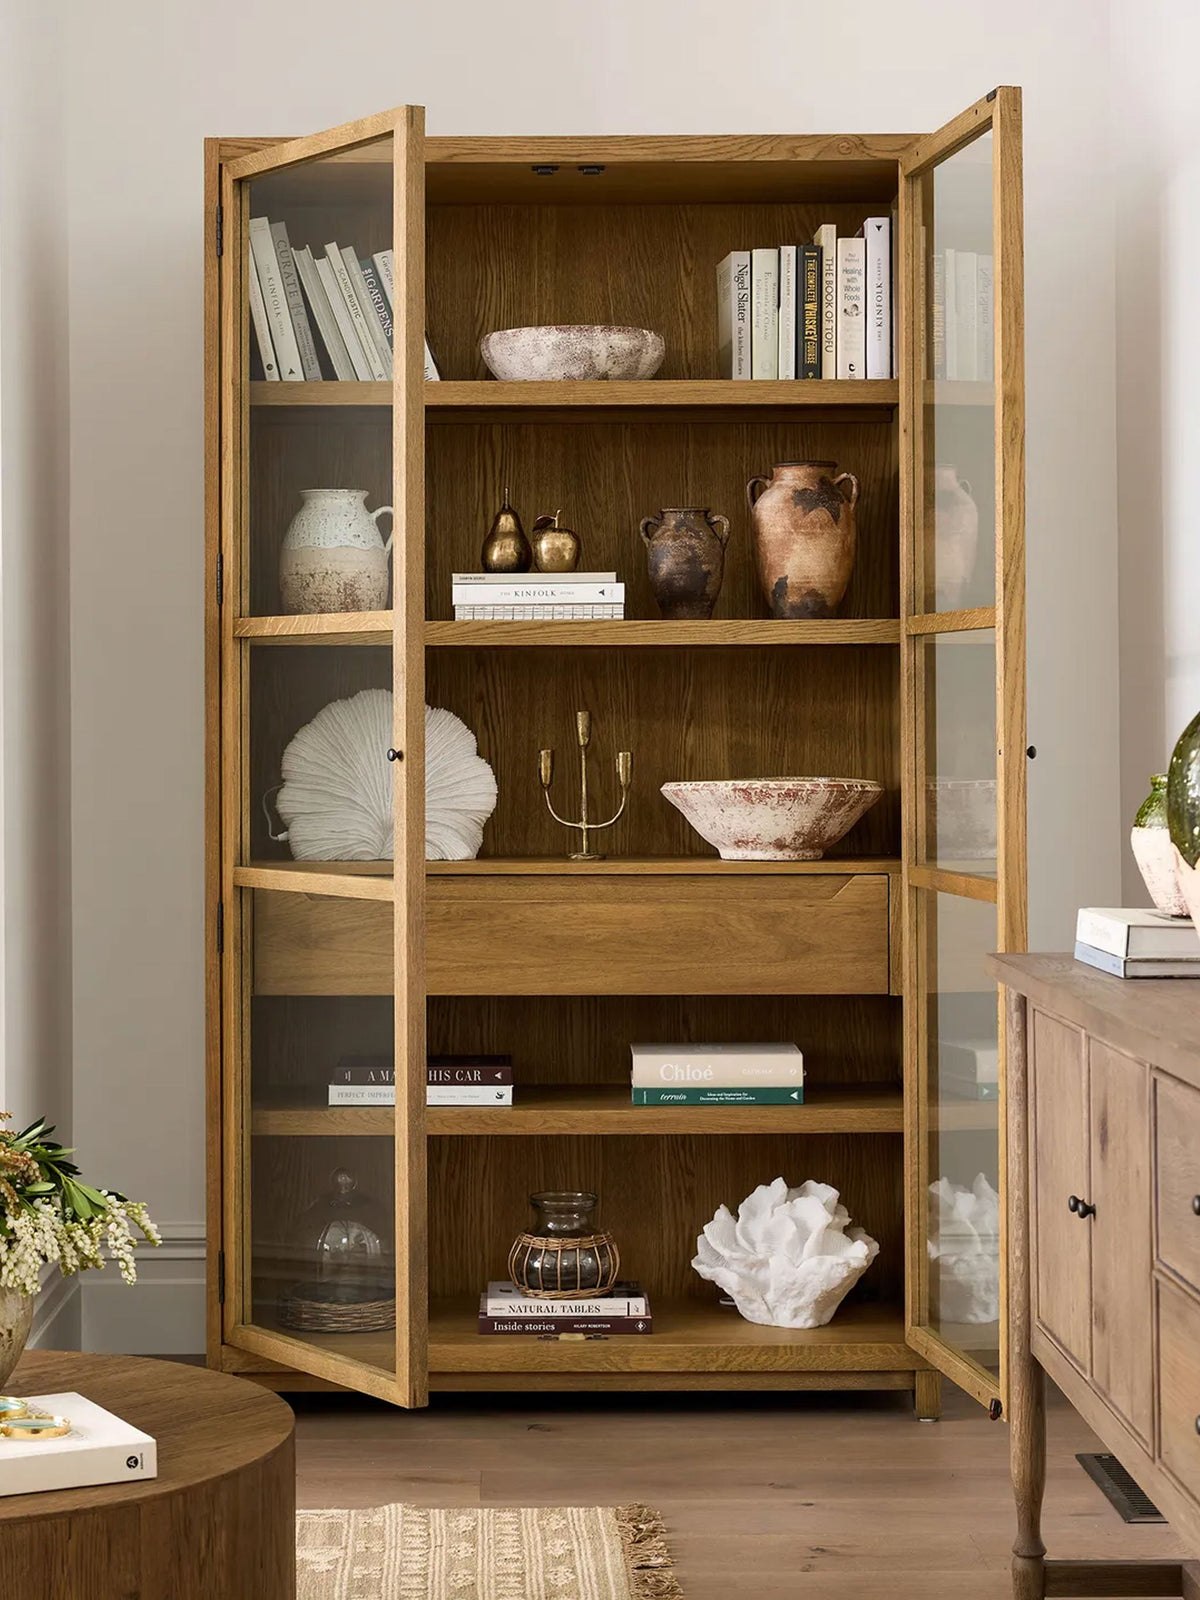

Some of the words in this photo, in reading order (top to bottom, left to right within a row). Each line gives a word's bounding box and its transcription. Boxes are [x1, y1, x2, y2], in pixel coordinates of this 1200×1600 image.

[276, 239, 298, 299] CURATE
[734, 263, 749, 291] Nigel
[824, 257, 834, 277] THE
[267, 276, 280, 319] KINFOLK
[366, 279, 394, 337] GARDENS
[737, 292, 749, 323] Slater
[825, 280, 834, 309] BOOK
[844, 293, 861, 301] Foods
[804, 302, 818, 342] WHISKEY
[825, 311, 834, 324] OF
[825, 326, 834, 353] TOFU
[367, 1070, 376, 1082] A
[428, 1070, 451, 1082] HIS
[455, 1070, 482, 1082] CAR
[659, 1063, 714, 1081] Chloé
[508, 1304, 558, 1313] NATURAL
[560, 1304, 602, 1313] TABLES
[493, 1321, 522, 1331] Inside
[524, 1322, 556, 1331] stories
